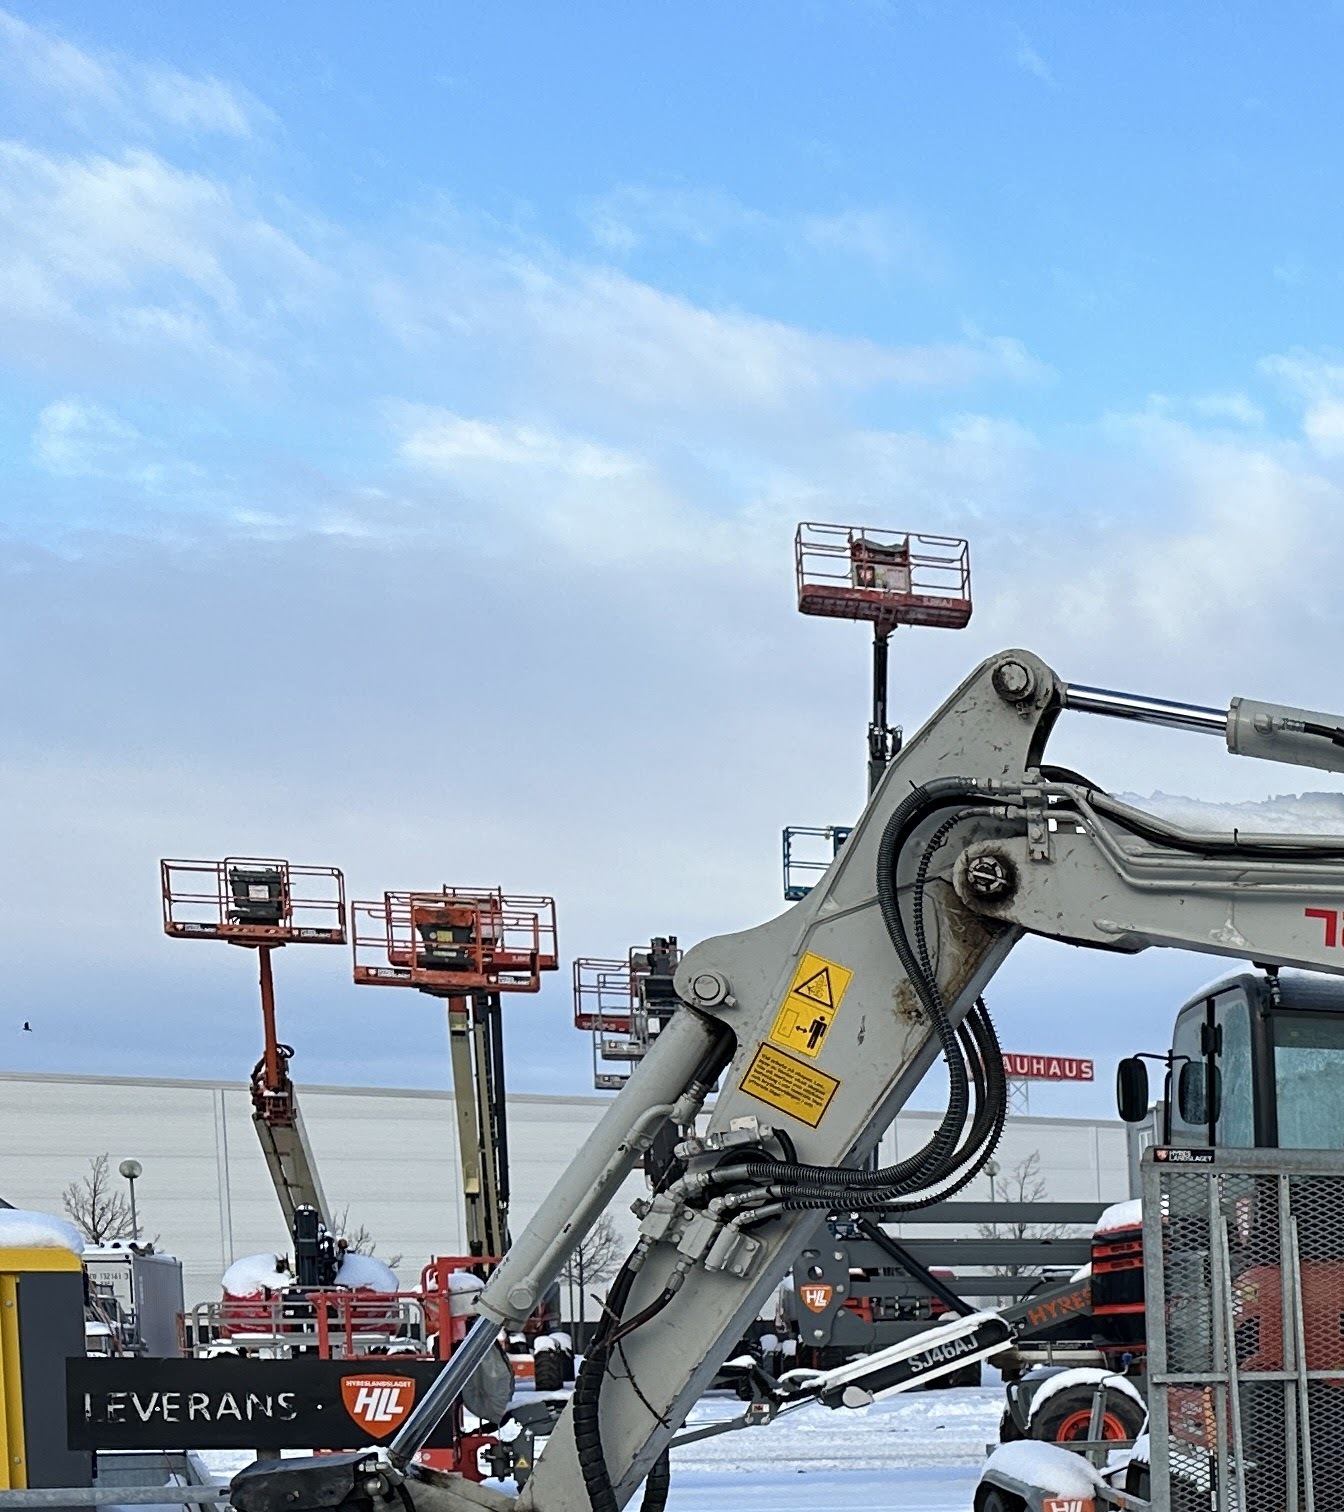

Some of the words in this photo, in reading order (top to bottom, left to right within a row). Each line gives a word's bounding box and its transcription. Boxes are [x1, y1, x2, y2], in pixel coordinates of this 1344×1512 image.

[1002, 1055, 1093, 1078] AUHAUS
[907, 1334, 979, 1372] SJ46AJ
[84, 1391, 298, 1423] LEVERANS
[353, 1387, 404, 1423] HLL
